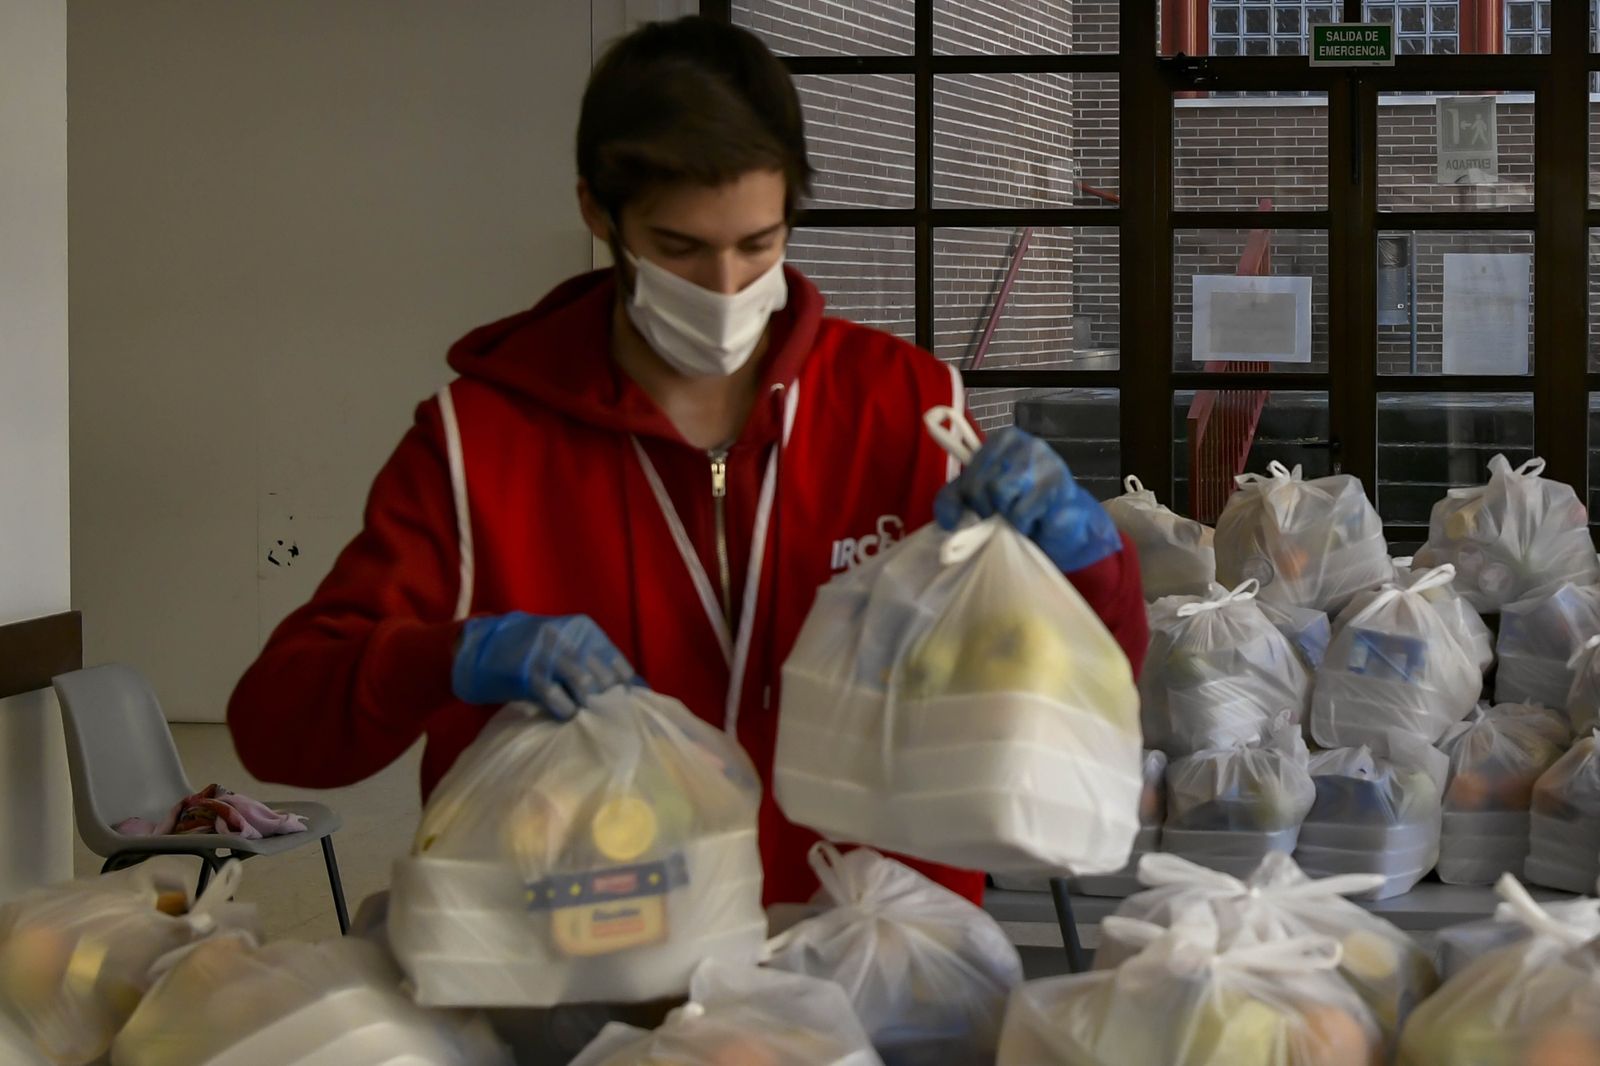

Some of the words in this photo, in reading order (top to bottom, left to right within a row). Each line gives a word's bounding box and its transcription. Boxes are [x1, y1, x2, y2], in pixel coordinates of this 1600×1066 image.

[1326, 31, 1362, 42] SALIDA
[1365, 31, 1379, 42] DE
[1319, 45, 1386, 56] EMERGENCIA
